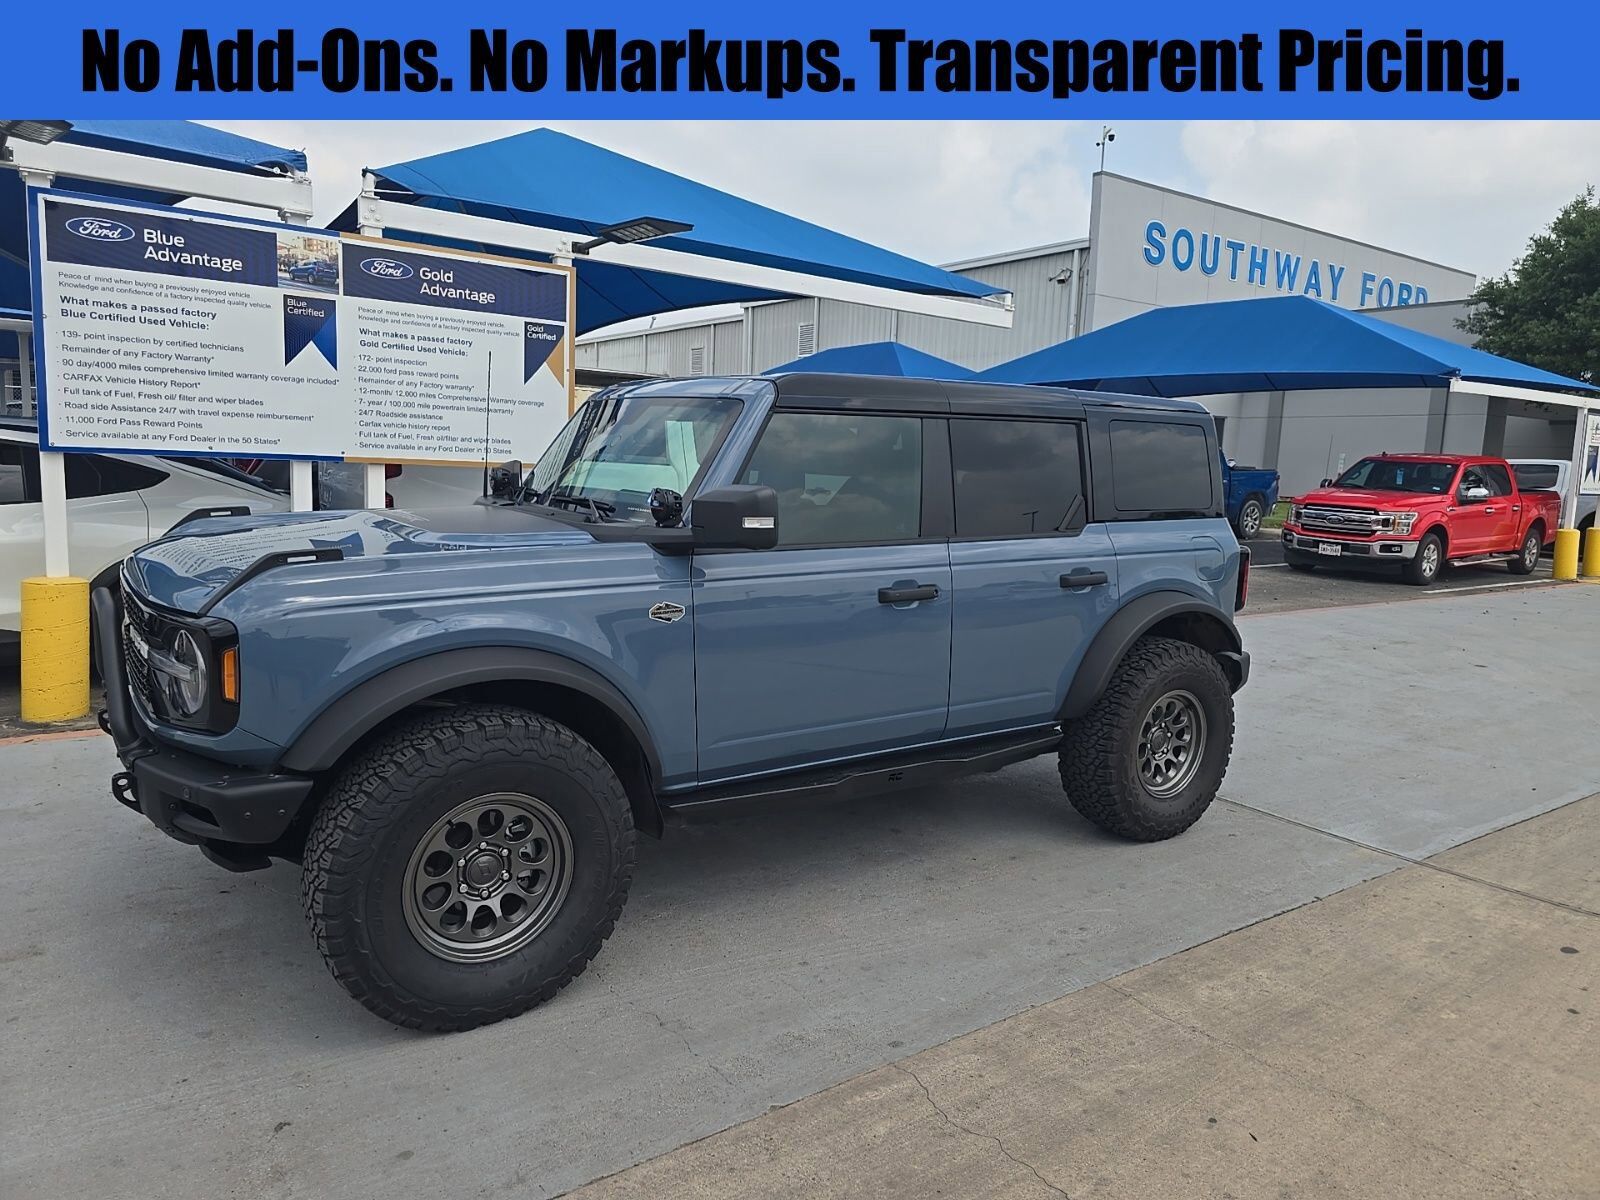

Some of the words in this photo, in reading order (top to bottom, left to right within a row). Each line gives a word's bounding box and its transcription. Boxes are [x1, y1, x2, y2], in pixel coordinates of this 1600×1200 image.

[78, 219, 123, 240] Ford
[143, 228, 185, 248] Blue
[143, 246, 243, 272] Advantage
[370, 259, 403, 278] Ford
[1143, 219, 1346, 302] SOUTHWAY
[1360, 271, 1428, 308] FORD
[419, 267, 454, 283] Gold
[419, 282, 496, 304] Advantage
[59, 294, 89, 306] What
[92, 299, 127, 310] makes
[140, 304, 178, 315] passed
[181, 306, 216, 320] factory
[287, 298, 308, 308] Blue
[287, 306, 325, 318] Certified
[60, 309, 86, 320] Blue
[89, 311, 135, 324] Certified
[138, 315, 166, 327] Used
[168, 318, 210, 330] Vehicle:
[527, 324, 544, 333] Gold
[83, 333, 105, 341] point
[107, 334, 151, 345] inspection
[152, 338, 163, 347] by
[165, 340, 198, 348] certified
[199, 342, 244, 352] technicians
[358, 327, 380, 338] What
[382, 330, 408, 340] makes
[417, 335, 444, 344] passed
[446, 335, 472, 348] factory
[527, 332, 557, 341] Certified
[61, 344, 110, 355] Remainder
[123, 350, 139, 358] any
[141, 350, 172, 361] Factory
[359, 339, 379, 349] Gold
[381, 341, 414, 352] Certified
[416, 344, 436, 354] Used
[62, 359, 74, 367] 90
[76, 360, 117, 370] day/4000
[118, 363, 141, 371] miles
[143, 366, 206, 376] comprehensive
[207, 369, 234, 378] limited
[235, 373, 268, 381] warranty
[270, 375, 304, 384] coverage
[62, 373, 103, 382] CARFAX
[104, 375, 136, 384] Vehicle
[138, 378, 168, 388] History
[63, 387, 79, 395] Full
[82, 388, 101, 396] tank
[137, 391, 162, 400] Fresh
[214, 396, 236, 405] wiper
[238, 397, 264, 406] blades
[64, 401, 88, 410] Road
[90, 403, 108, 411] side
[110, 404, 156, 413] Assistance
[97, 417, 117, 425] Ford
[119, 418, 141, 426] Pass
[142, 419, 175, 428] Reward
[65, 429, 98, 438] Service
[100, 431, 138, 440] available
